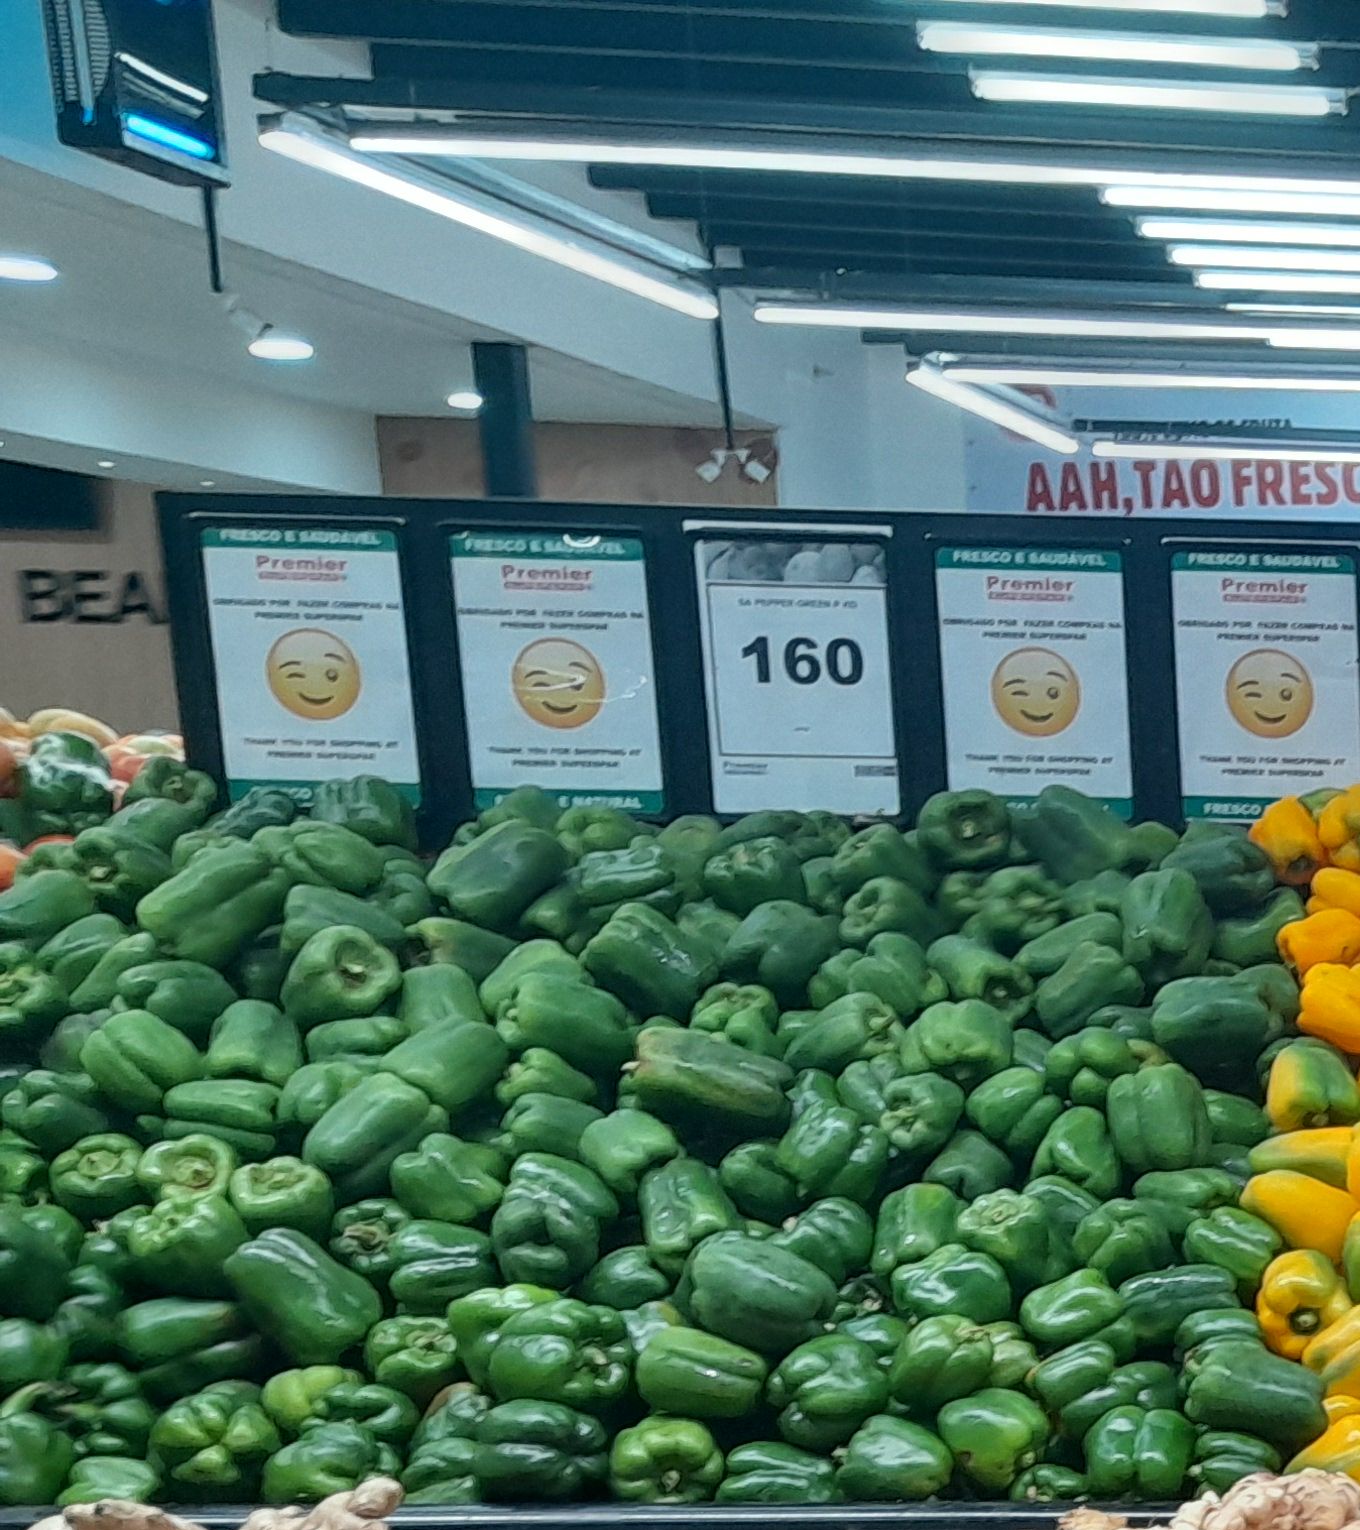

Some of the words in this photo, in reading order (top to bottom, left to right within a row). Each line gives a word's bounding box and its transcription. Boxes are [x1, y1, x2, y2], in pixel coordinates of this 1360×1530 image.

[256, 555, 347, 571] Premier
[953, 551, 1012, 563] FRESCO
[1015, 552, 1025, 564] E
[502, 564, 592, 580] Premier
[987, 576, 1073, 592] Premier
[1221, 578, 1308, 593] Premier
[742, 635, 863, 686] 160
